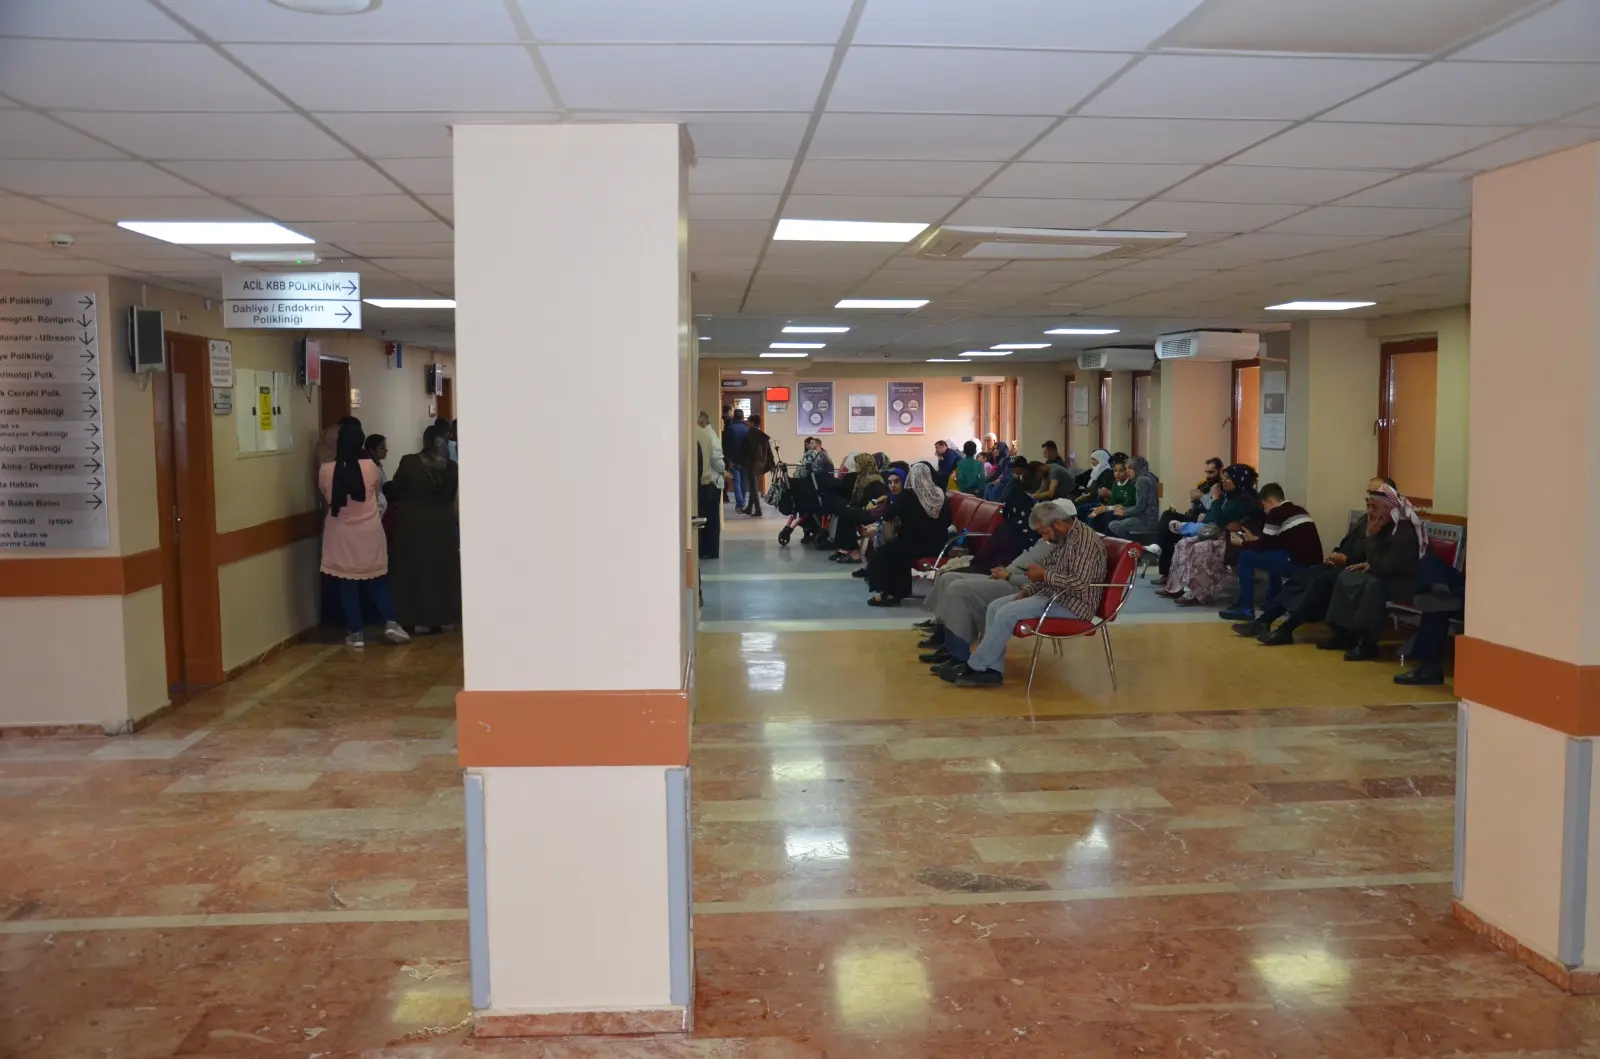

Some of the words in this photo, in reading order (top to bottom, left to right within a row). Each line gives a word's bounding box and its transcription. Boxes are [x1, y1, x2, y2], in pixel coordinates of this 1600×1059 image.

[266, 281, 286, 291] KBB
[289, 280, 342, 291] POLİKLİNİK
[232, 304, 269, 314] Dahliye
[278, 303, 324, 313] Endokrin
[38, 315, 74, 325] Röntgen
[253, 315, 303, 325] Polikliniği
[40, 334, 76, 342] Ultrason
[7, 389, 39, 397] Cerrahi
